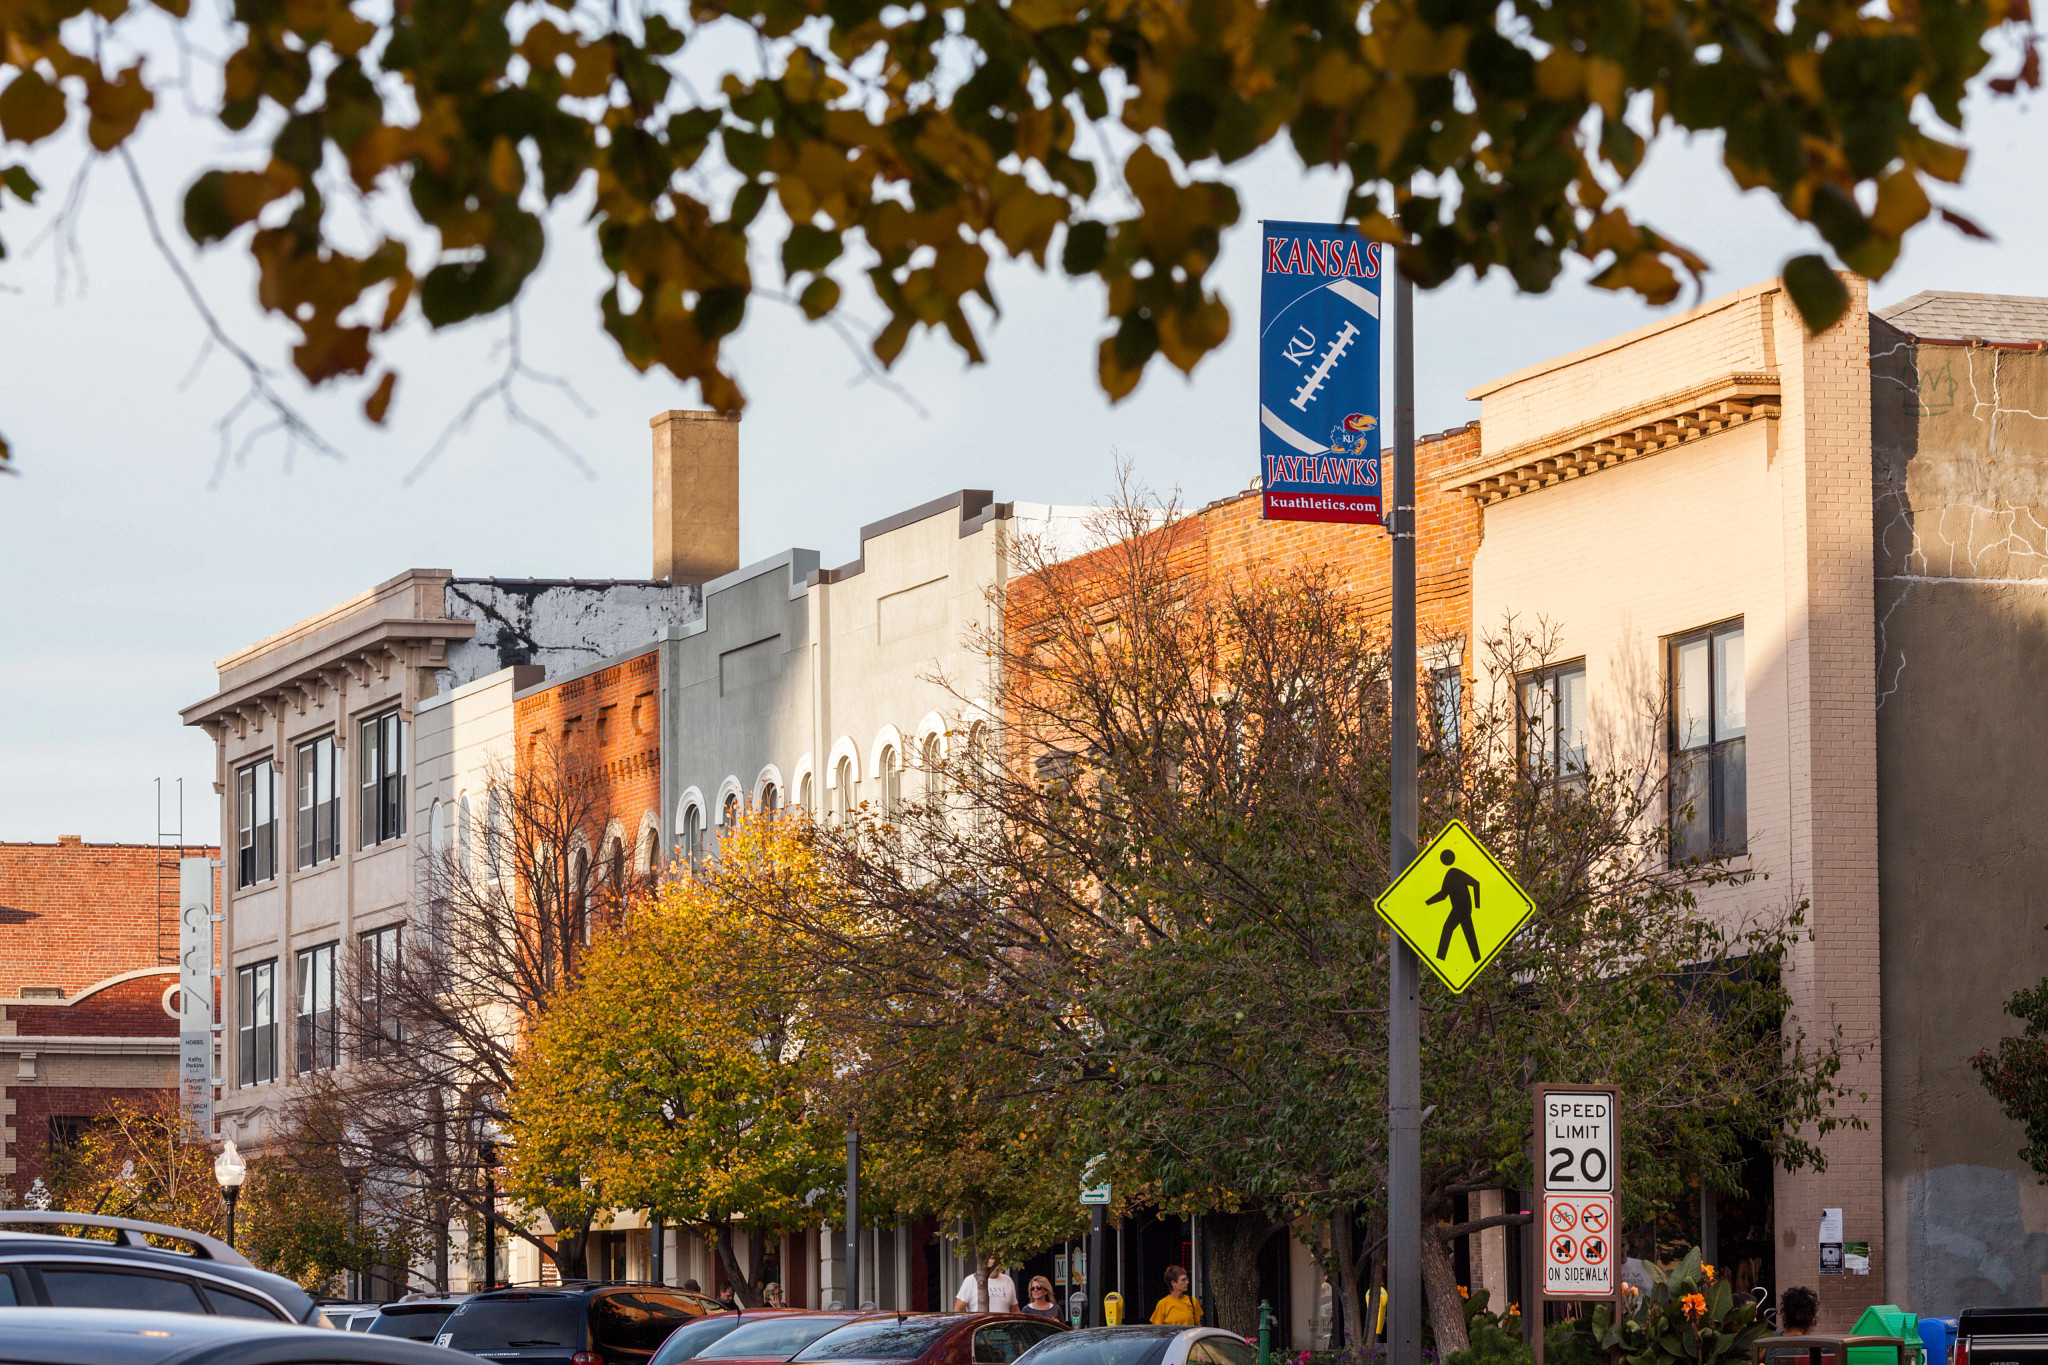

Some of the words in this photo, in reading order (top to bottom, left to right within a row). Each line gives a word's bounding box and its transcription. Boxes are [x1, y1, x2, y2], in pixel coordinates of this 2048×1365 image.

[1266, 237, 1380, 279] KANSAS
[1281, 324, 1316, 368] KU
[1342, 434, 1355, 444] KU
[1266, 455, 1378, 489] JAYHAWKS
[1270, 495, 1377, 512] kuathletics.com
[1549, 1103, 1607, 1118] SPEED
[1555, 1125, 1600, 1139] LIMIT
[1549, 1147, 1607, 1183] 20
[1548, 1267, 1561, 1281] ON
[1564, 1267, 1609, 1281] SIDEWALK
